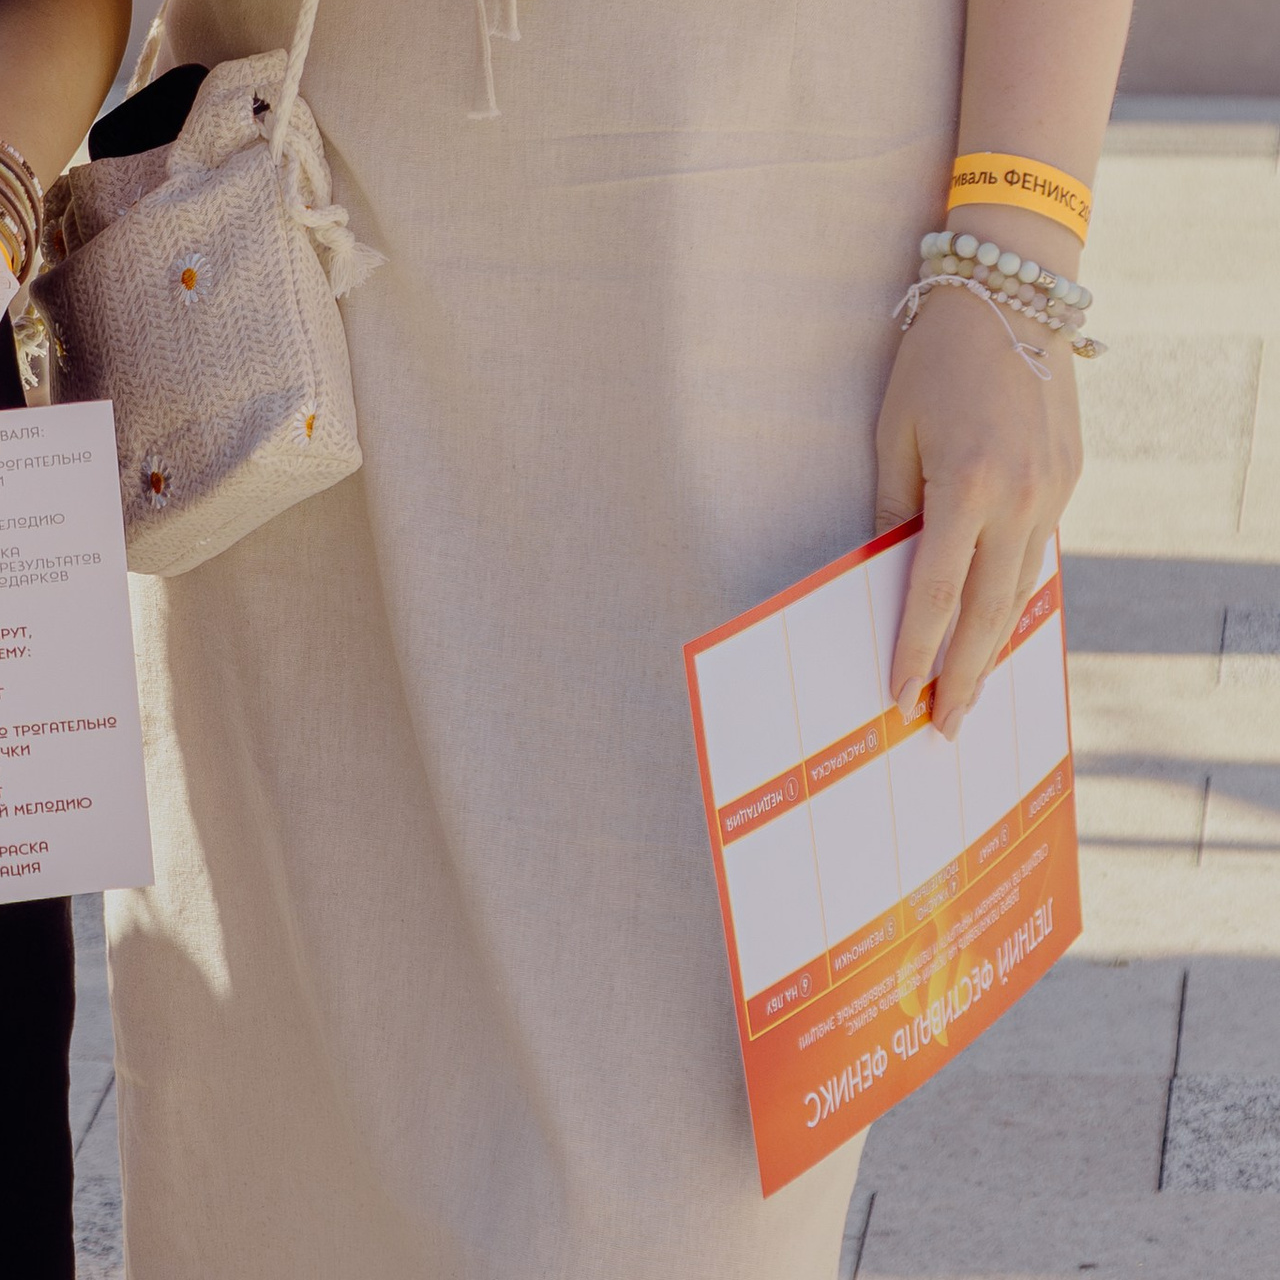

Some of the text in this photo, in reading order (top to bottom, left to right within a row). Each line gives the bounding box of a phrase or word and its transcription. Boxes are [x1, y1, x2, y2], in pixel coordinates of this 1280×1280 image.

[1004, 169, 1077, 211] ФЕНИКС
[0, 552, 102, 573] РЕЗУЛЬТАТОВ
[12, 716, 117, 737] ТРОГАТЕЛЬНО
[811, 739, 866, 781] РАСКРАСКА
[14, 797, 93, 816] МЕЛОДИЮ
[726, 789, 784, 832] МЕДИТАЦИЯ
[833, 929, 885, 971] РЕЗИНОЧКИ
[766, 994, 784, 1016] ЛБУ
[784, 985, 798, 1003] НА
[804, 897, 1053, 1129] ЛЕТНИЙ ФЕСТИВАЛЬ ФЕНИКС
